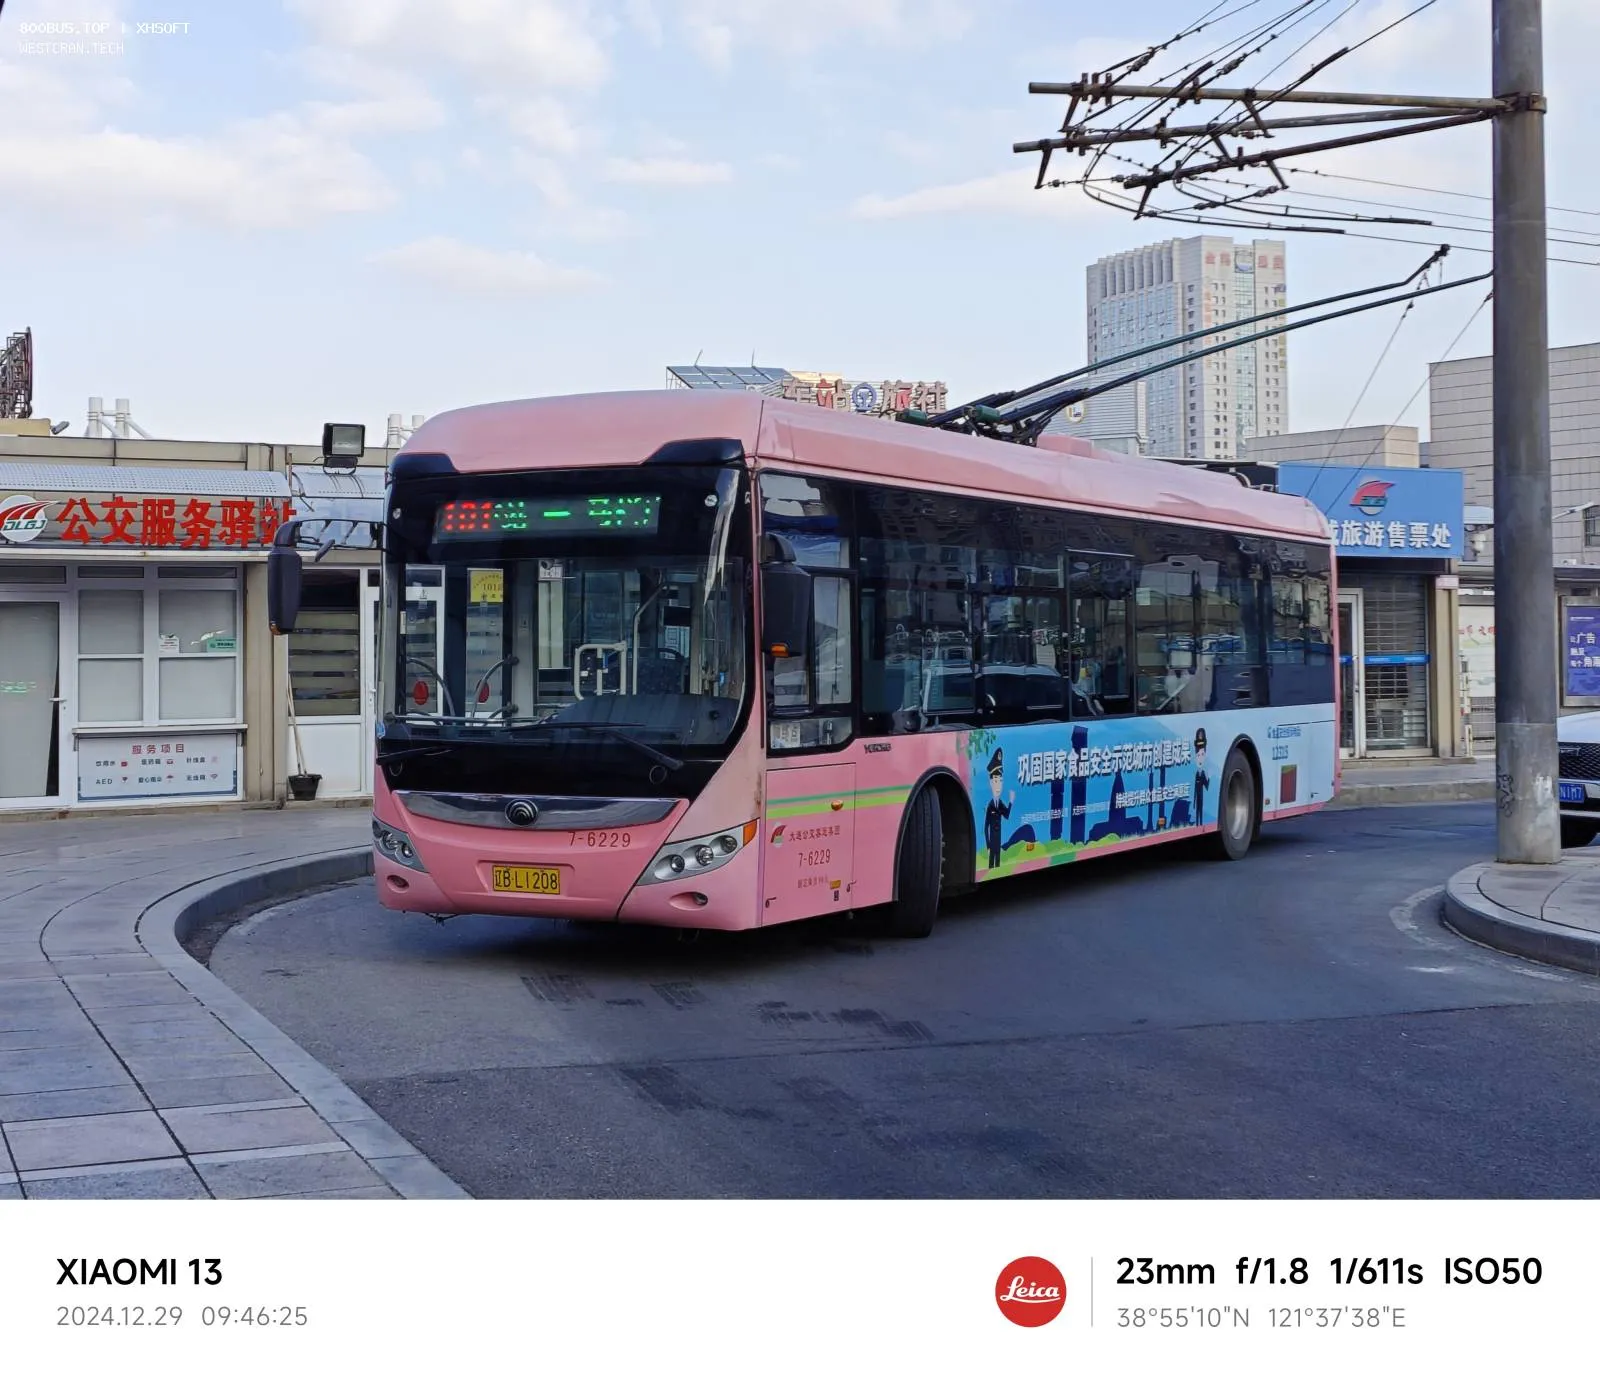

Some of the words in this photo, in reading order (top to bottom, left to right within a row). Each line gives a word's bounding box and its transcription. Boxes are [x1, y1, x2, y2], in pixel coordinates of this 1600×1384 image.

[56, 496, 297, 548] 公交服务驿站
[132, 744, 184, 754] 服务项目
[568, 831, 631, 847] 7-6229
[798, 849, 831, 867] 7-6229
